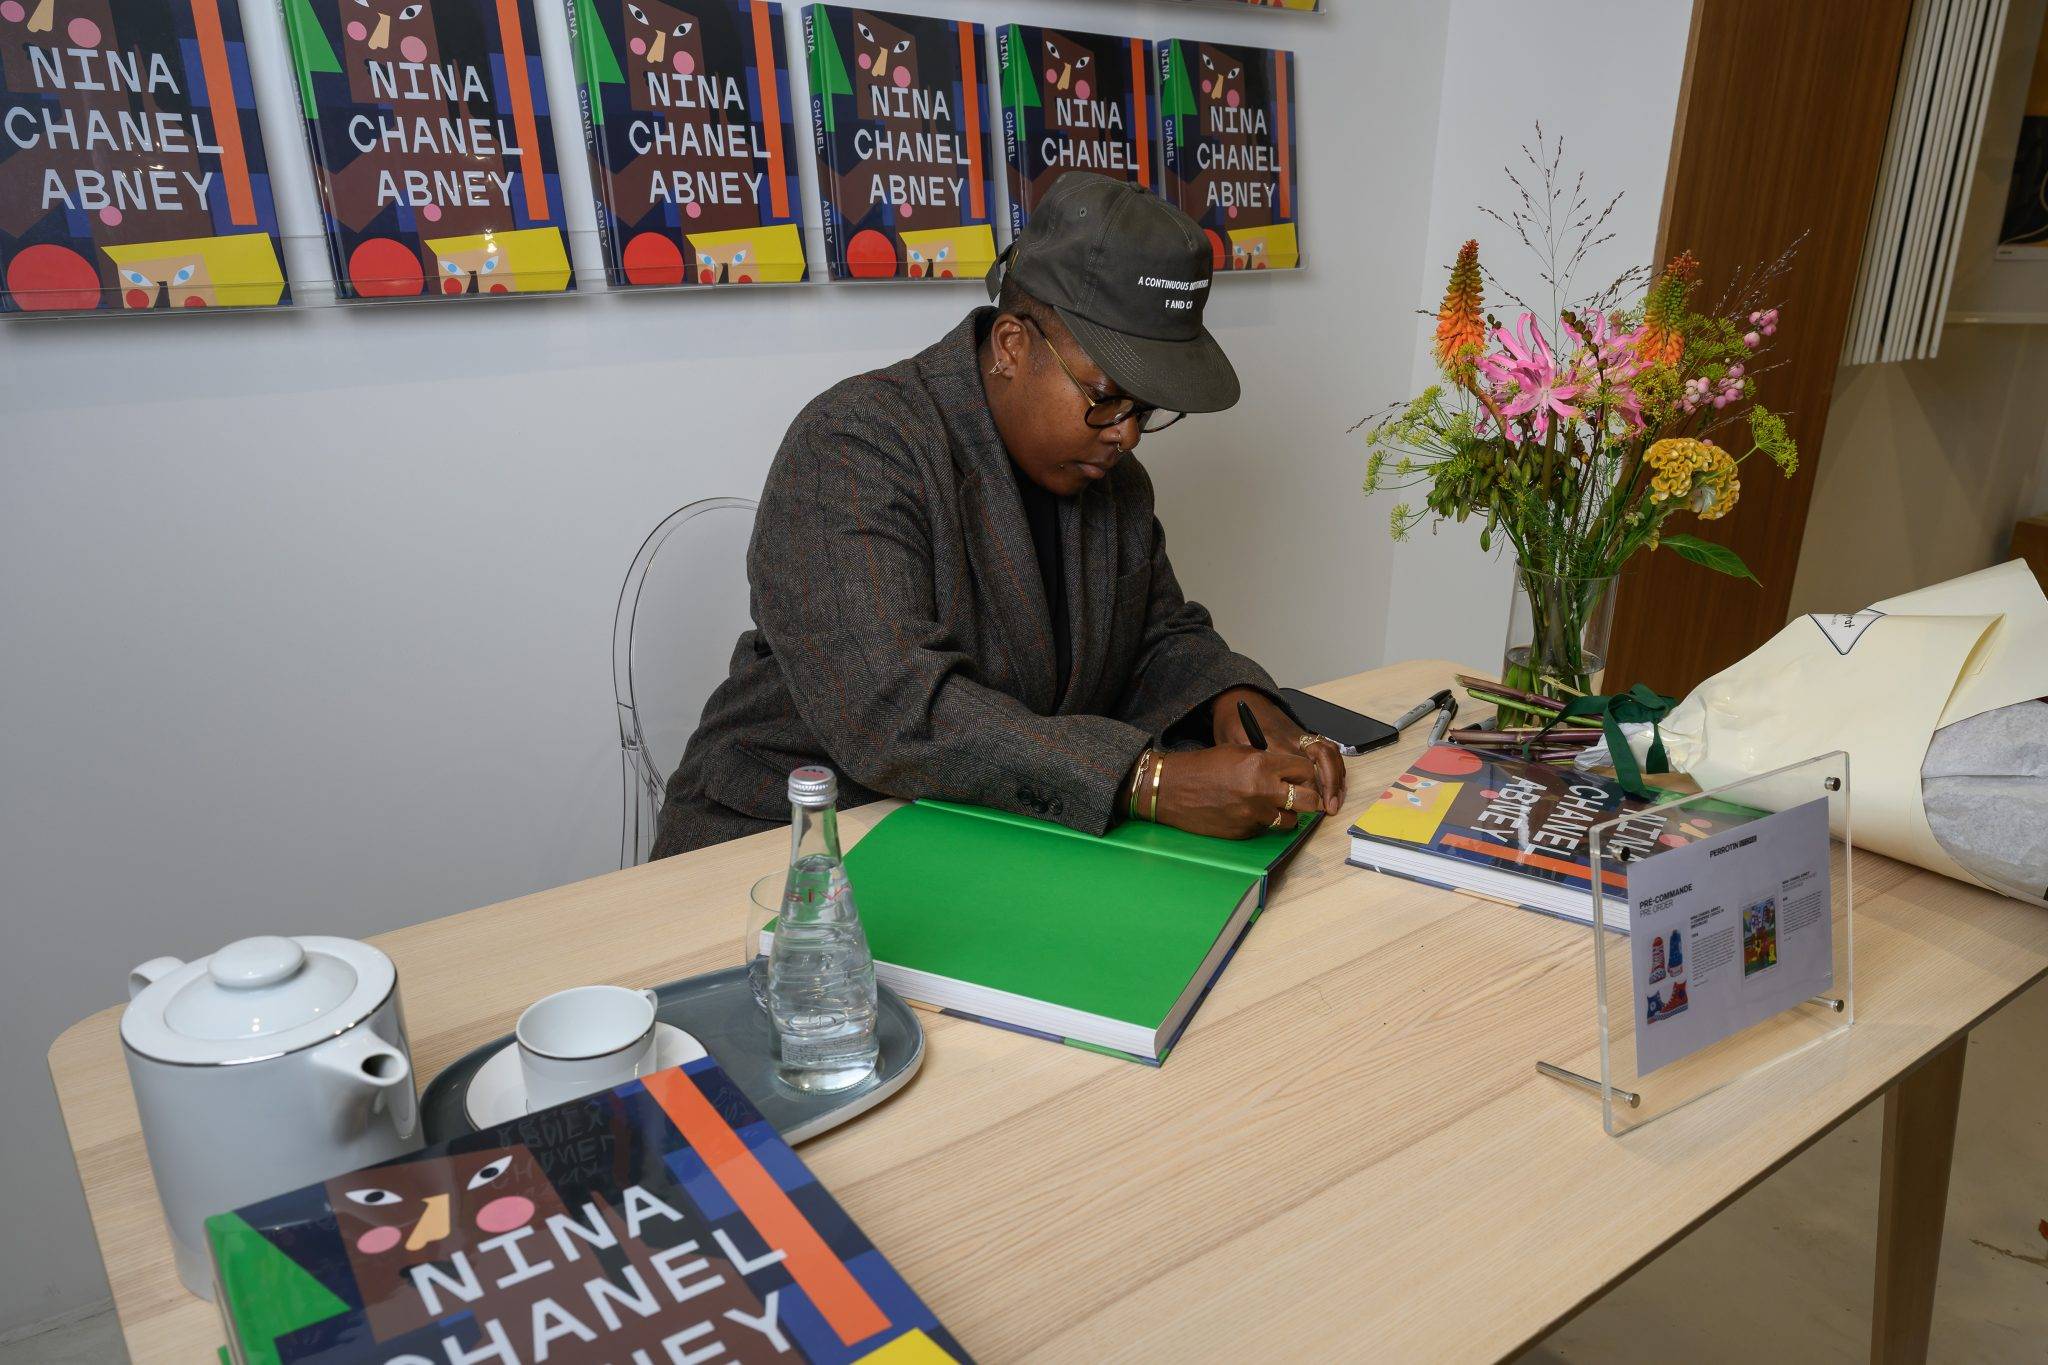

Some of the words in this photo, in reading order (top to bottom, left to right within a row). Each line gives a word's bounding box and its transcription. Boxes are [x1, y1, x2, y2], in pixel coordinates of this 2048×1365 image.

[27, 45, 180, 95] NINA
[368, 60, 489, 103] NINA
[1161, 49, 1170, 81] NINA
[648, 71, 744, 110] NINA
[871, 84, 950, 120] NINA
[4, 106, 224, 154] CHANEL
[805, 15, 814, 54] NINA
[813, 100, 824, 154] CHANEL
[823, 200, 833, 244] ABNEY
[1056, 97, 1123, 130] NINA
[1211, 107, 1267, 135] NINA
[348, 114, 523, 156] CHANEL
[629, 120, 771, 158] CHANEL
[854, 128, 971, 165] CHANEL
[1000, 35, 1008, 70] NINA
[1005, 111, 1015, 162] CHANEL
[1012, 203, 1020, 241] ABNE
[1041, 137, 1139, 170] CHANEL
[1165, 119, 1174, 166] CHANEL
[580, 89, 594, 150] CHANEL
[596, 200, 608, 248] ABNEY
[1197, 143, 1281, 172] CHANEL
[41, 169, 213, 211] ABNEY
[376, 169, 517, 207] ABNEY
[650, 170, 763, 204] ABNEY
[869, 174, 965, 207] ABNEY
[1206, 181, 1275, 208] ABNEY
[1138, 276, 1144, 286] A
[1145, 277, 1189, 291] CONTINUOUS
[1471, 776, 1547, 843] ABNEY
[1524, 785, 1610, 856] CHANEL
[1710, 842, 1739, 858] PERROTIN
[410, 1185, 683, 1317] NINA
[383, 1229, 787, 1365] HANEL
